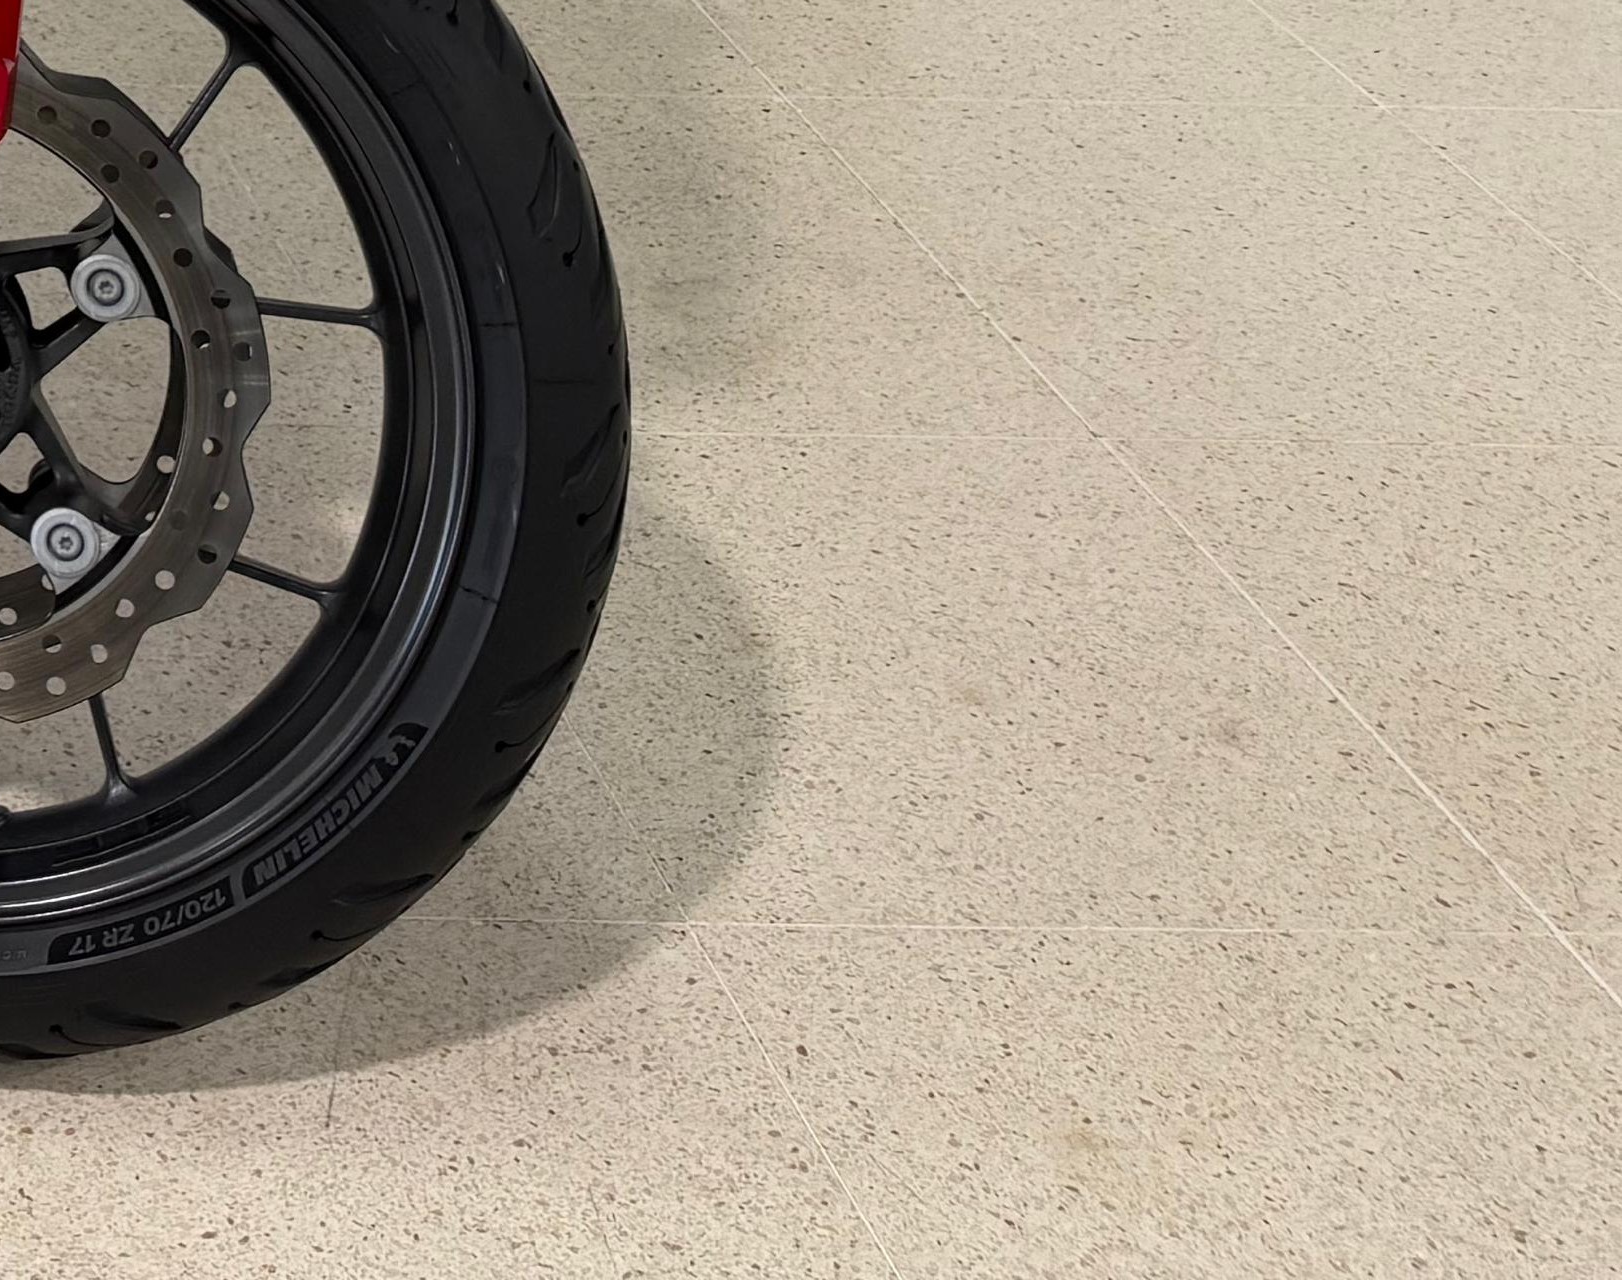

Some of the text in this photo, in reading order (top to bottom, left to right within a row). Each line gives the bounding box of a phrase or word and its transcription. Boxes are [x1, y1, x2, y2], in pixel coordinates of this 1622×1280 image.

[255, 761, 384, 886] MICHELIN
[69, 887, 228, 957] 120/70 ZR 17
